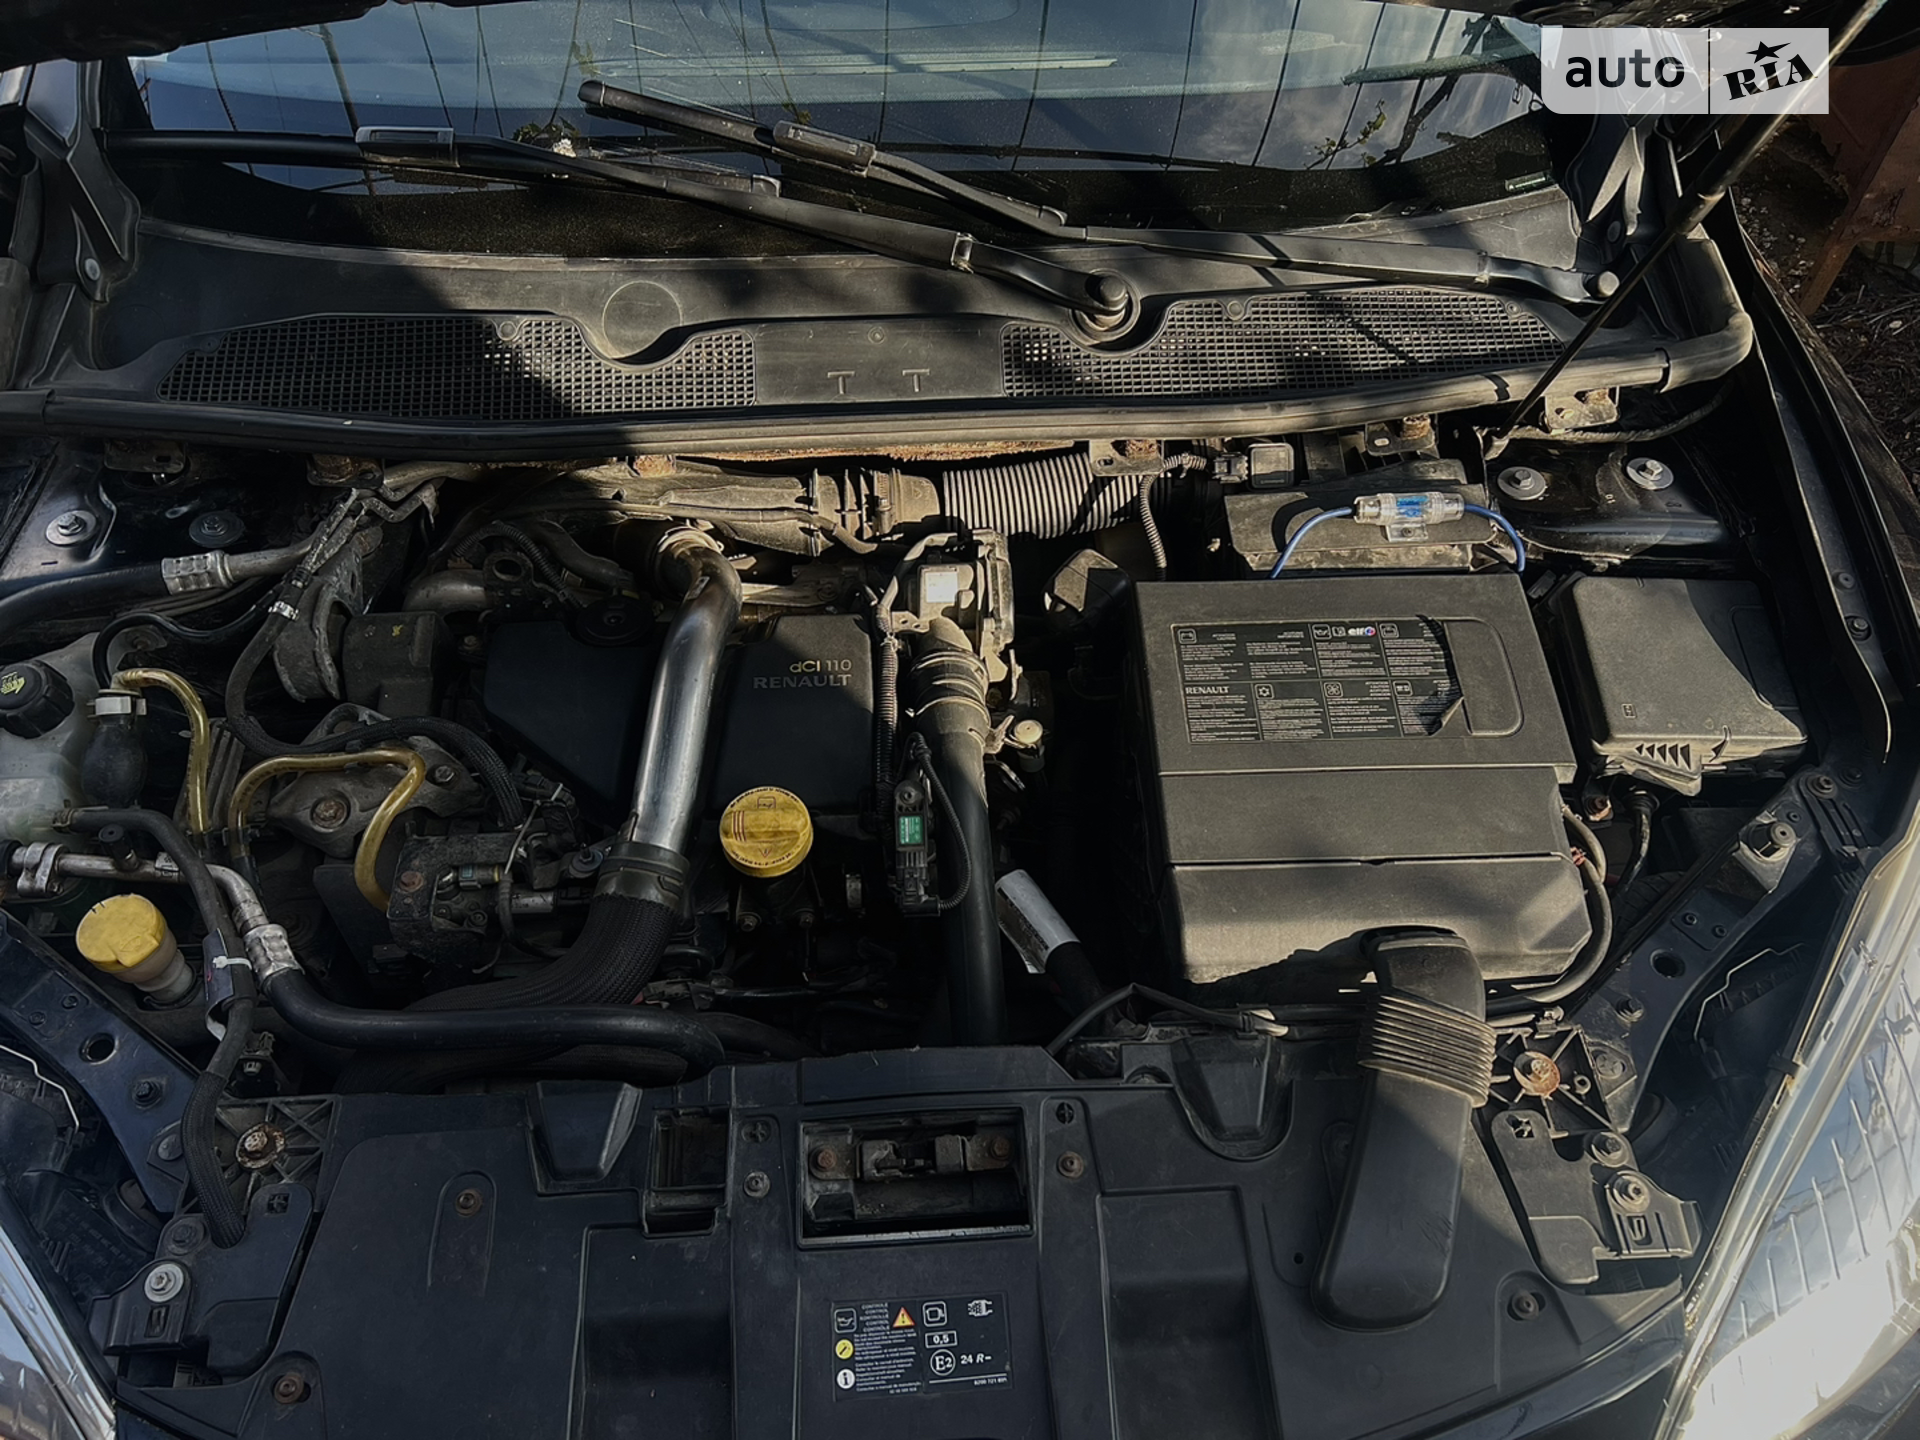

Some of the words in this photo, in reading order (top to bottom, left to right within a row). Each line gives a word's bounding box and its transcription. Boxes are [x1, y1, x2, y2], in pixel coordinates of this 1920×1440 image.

[1346, 627, 1366, 637] elf
[825, 659, 852, 671] 110
[753, 674, 852, 689] RENAULT
[1185, 686, 1230, 695] RENAULT
[935, 1355, 952, 1371] E2
[960, 1354, 973, 1364] 24
